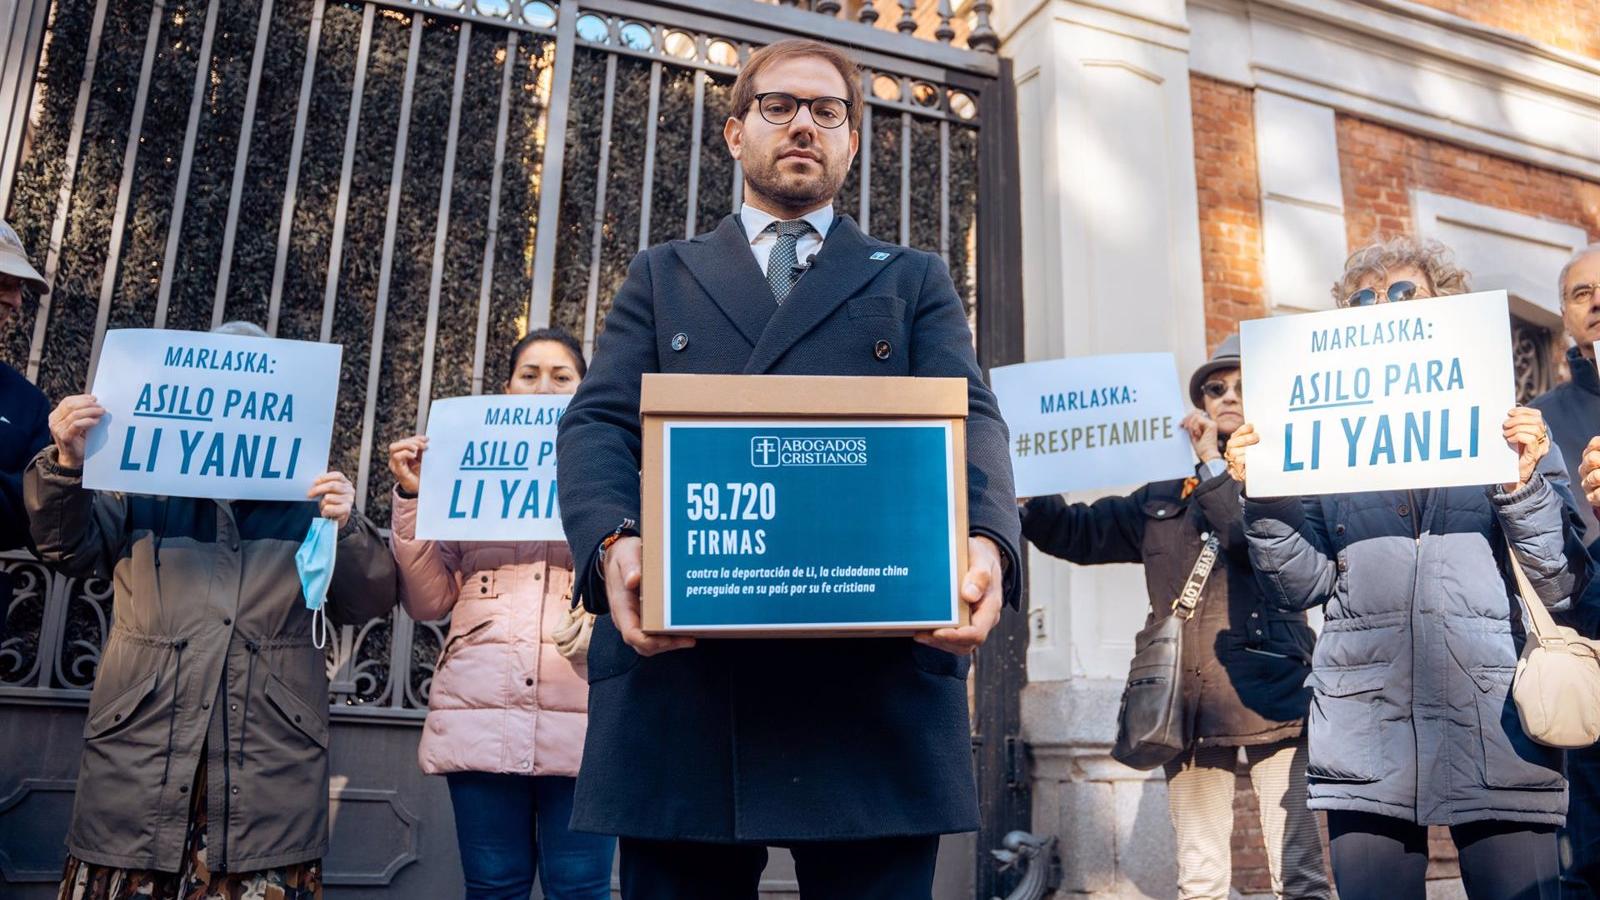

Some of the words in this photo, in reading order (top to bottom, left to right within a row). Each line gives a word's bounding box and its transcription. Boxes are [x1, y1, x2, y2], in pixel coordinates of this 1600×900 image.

[1311, 317, 1433, 353] MARLASKA:
[164, 346, 277, 374] MARLASKA:
[1040, 385, 1137, 414] MARLASKA:
[1288, 367, 1374, 413] ASILO
[1384, 357, 1465, 397] PARA
[134, 382, 214, 422] ASILO
[222, 389, 294, 423] PARA
[119, 426, 163, 473] LI
[179, 429, 302, 480] YANLI
[781, 439, 867, 452] ABOGADOS
[1015, 416, 1174, 458] #RESPETAMIFE
[1282, 420, 1321, 472] LI
[1340, 406, 1480, 468] YANLI
[459, 440, 529, 471] ASILO
[781, 452, 868, 464] CRISTIANOS
[448, 479, 485, 519] LI
[687, 482, 776, 521] 59.720
[687, 528, 766, 555] FIRMAS
[686, 568, 719, 579] contra
[720, 567, 730, 579] la
[731, 566, 791, 581] deportación
[791, 566, 805, 578] de
[805, 566, 818, 579] Li,
[819, 566, 829, 578] la
[830, 565, 881, 578] ciudadana
[882, 565, 909, 577] china
[686, 584, 741, 598] perseguida
[741, 585, 755, 595] en
[756, 585, 767, 595] su
[768, 582, 789, 597] país
[789, 584, 807, 597] por
[808, 584, 820, 594] su
[821, 582, 832, 594] fe
[833, 582, 876, 594] cristiana
